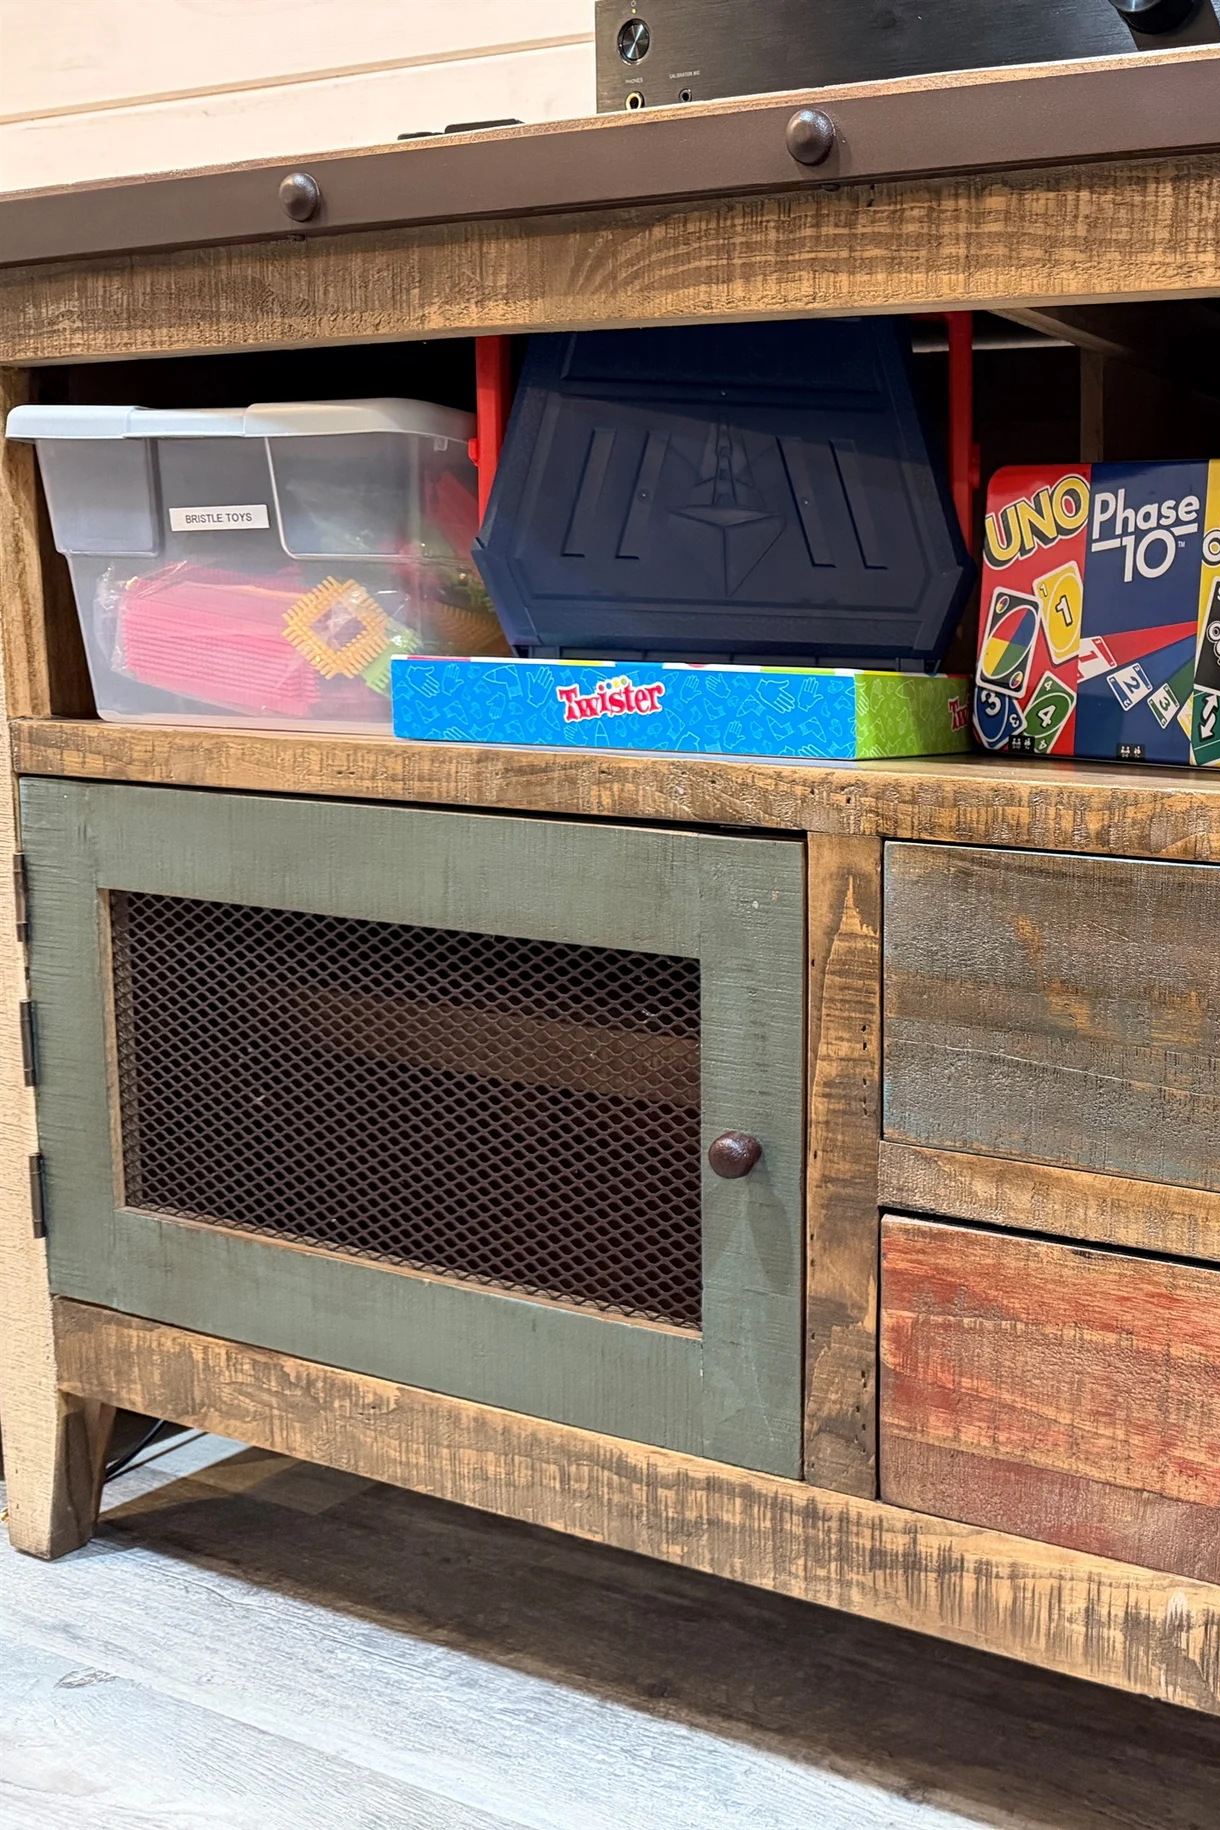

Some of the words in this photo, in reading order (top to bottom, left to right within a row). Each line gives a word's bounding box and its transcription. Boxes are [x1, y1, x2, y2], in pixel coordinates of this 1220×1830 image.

[185, 513, 223, 524] BRISTLE
[225, 513, 253, 522] TOYS
[983, 474, 1090, 567] UNO
[1092, 488, 1200, 539] Phase
[1040, 583, 1048, 597] 1
[1055, 595, 1073, 627] 1
[1044, 681, 1053, 691] 4
[1122, 676, 1141, 694] 2
[557, 680, 663, 721] Twister
[981, 690, 1002, 716] 3
[1159, 698, 1171, 712] 3
[1009, 714, 1019, 728] 3
[1037, 705, 1056, 728] 4
